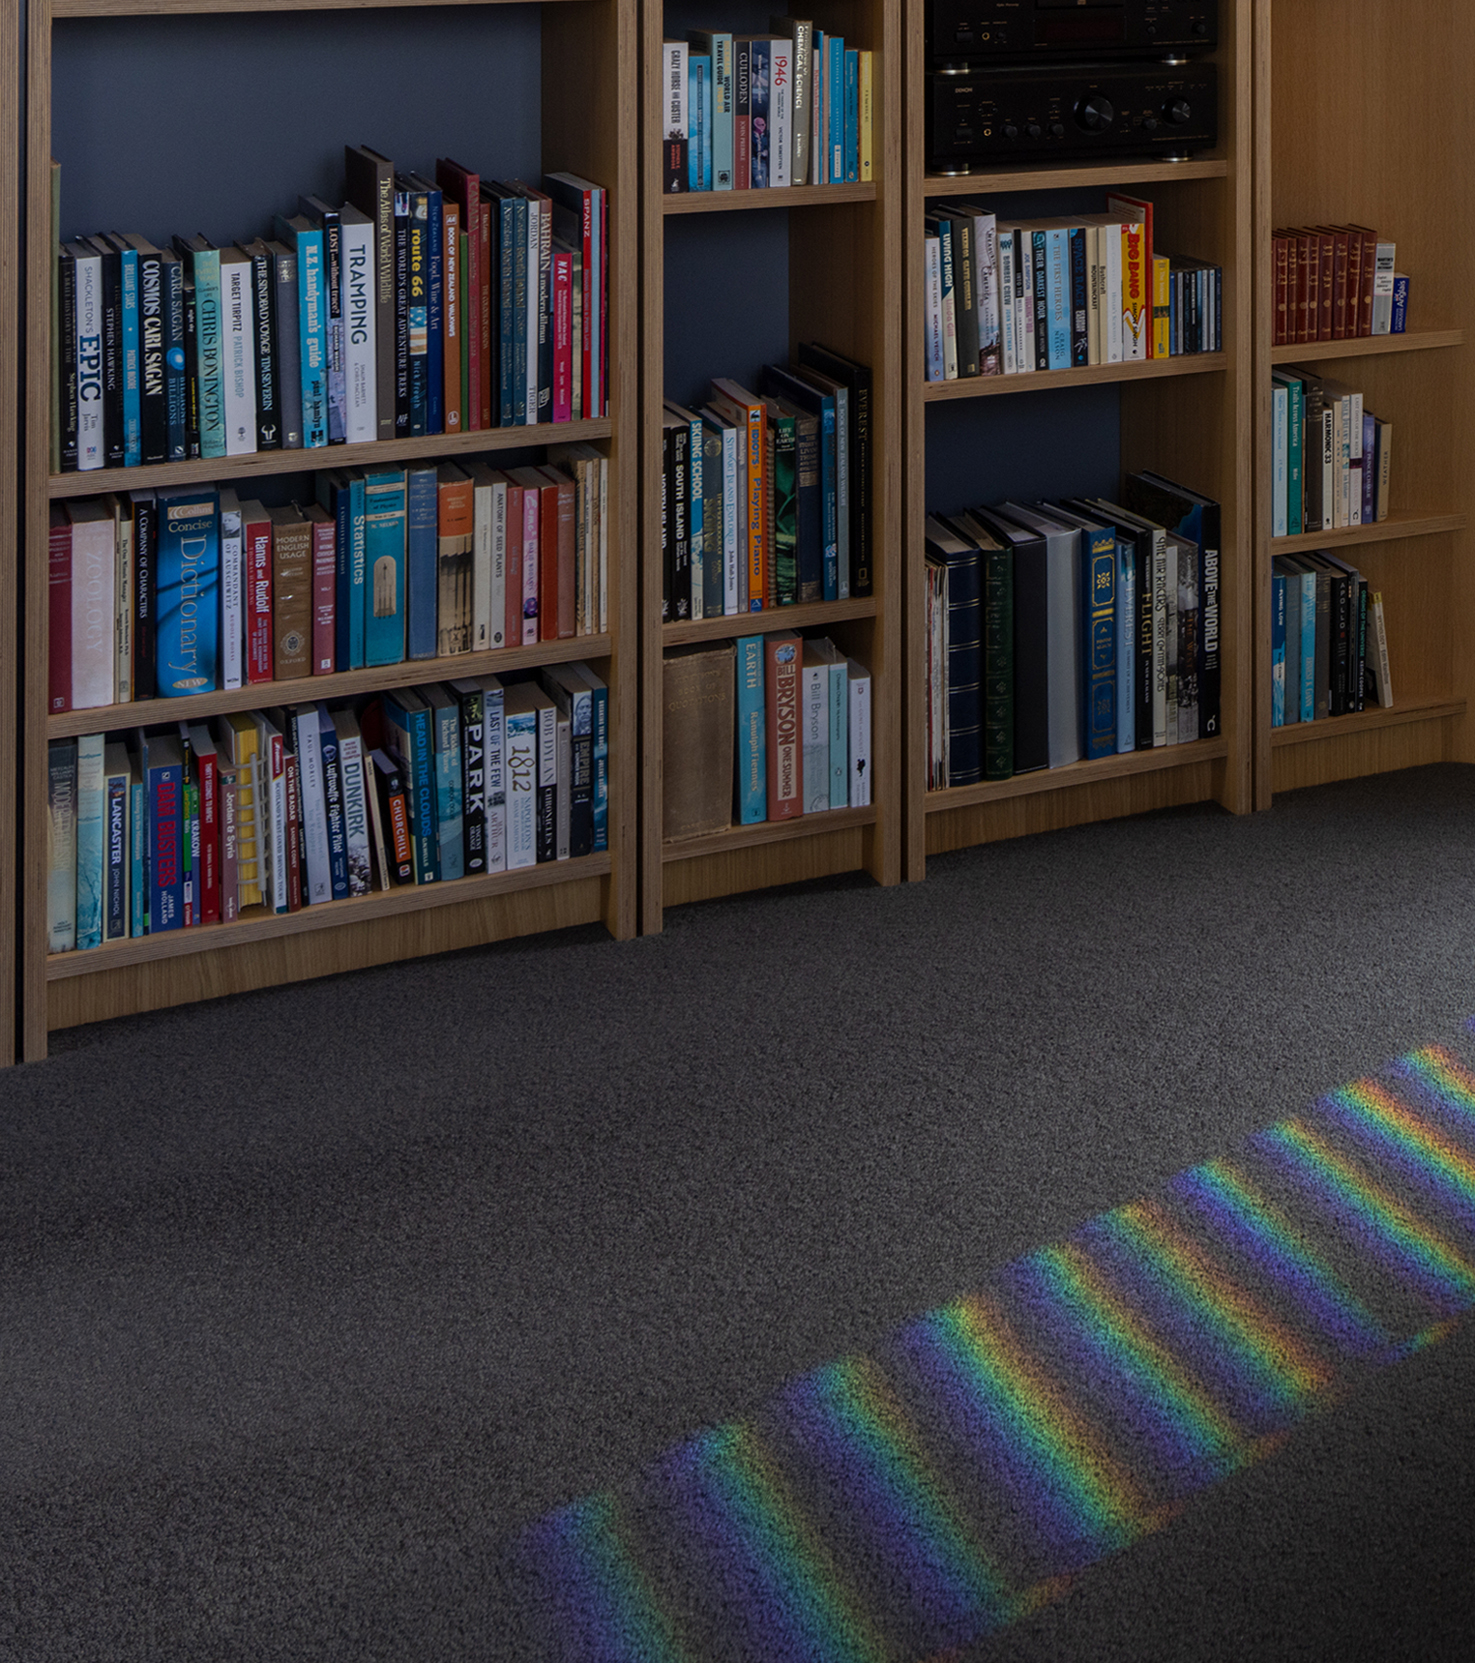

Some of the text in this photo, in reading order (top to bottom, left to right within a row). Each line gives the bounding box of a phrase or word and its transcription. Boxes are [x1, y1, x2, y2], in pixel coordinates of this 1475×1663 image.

[739, 52, 748, 104] CULLODEN
[775, 56, 788, 86] 1946
[380, 178, 391, 303] The Atlas of World Wildlife
[411, 229, 422, 297] route 66
[540, 213, 551, 270] BAHRAIN
[1003, 255, 1011, 283] BOMBER
[1128, 234, 1140, 299] BIG BANG
[84, 266, 94, 333] SHACKLETON'S
[305, 245, 322, 368] N.Z. handyman's guide
[350, 245, 367, 344] TRAMPING
[1396, 280, 1406, 307] Anglais
[107, 308, 115, 390] STEPHEN HAWKING
[142, 260, 162, 395] COSMOS CARL SAGAN
[80, 334, 101, 402] EPIC
[201, 300, 222, 431] CHRIS BONINGTON
[691, 422, 703, 501] SKIING SCHOOL
[751, 429, 759, 465] IDIOT'S
[1325, 454, 1331, 464] 33
[168, 522, 212, 533] Concise
[675, 464, 685, 539] SOUTH ISLAND
[751, 478, 763, 575] Playing Piano
[139, 517, 148, 554] COMPANY
[139, 557, 148, 567] OF
[276, 534, 310, 544] MODERN
[276, 543, 310, 553] ENGLISH
[279, 550, 307, 560] USAGE
[353, 515, 365, 585] Statistics
[139, 570, 148, 618] CHARACTERS
[168, 535, 206, 673] Dictionary
[254, 536, 270, 613] Hanns and Rudolf
[1204, 549, 1218, 652] ABOVE THE WORLD
[1141, 593, 1152, 656] FLIGHT
[177, 679, 203, 688] NEW
[746, 643, 757, 689] EARTH
[778, 665, 796, 676] BILL
[778, 676, 796, 746] BRYSON
[415, 713, 432, 836] HEAD IN THE CLOUDS
[467, 724, 484, 814] PARK
[508, 746, 535, 791] 1812
[543, 709, 555, 783] BOB DYLAN
[781, 747, 792, 797] ONE SUMMER
[111, 798, 122, 864] LANCASTER
[226, 792, 236, 824] Jordan
[344, 764, 364, 838] DUNKIRK
[392, 799, 407, 858] CHURCHILL
[156, 782, 177, 888] DAM BUSTERS
[191, 820, 201, 858] KRAKOW
[226, 835, 236, 859] Syria
